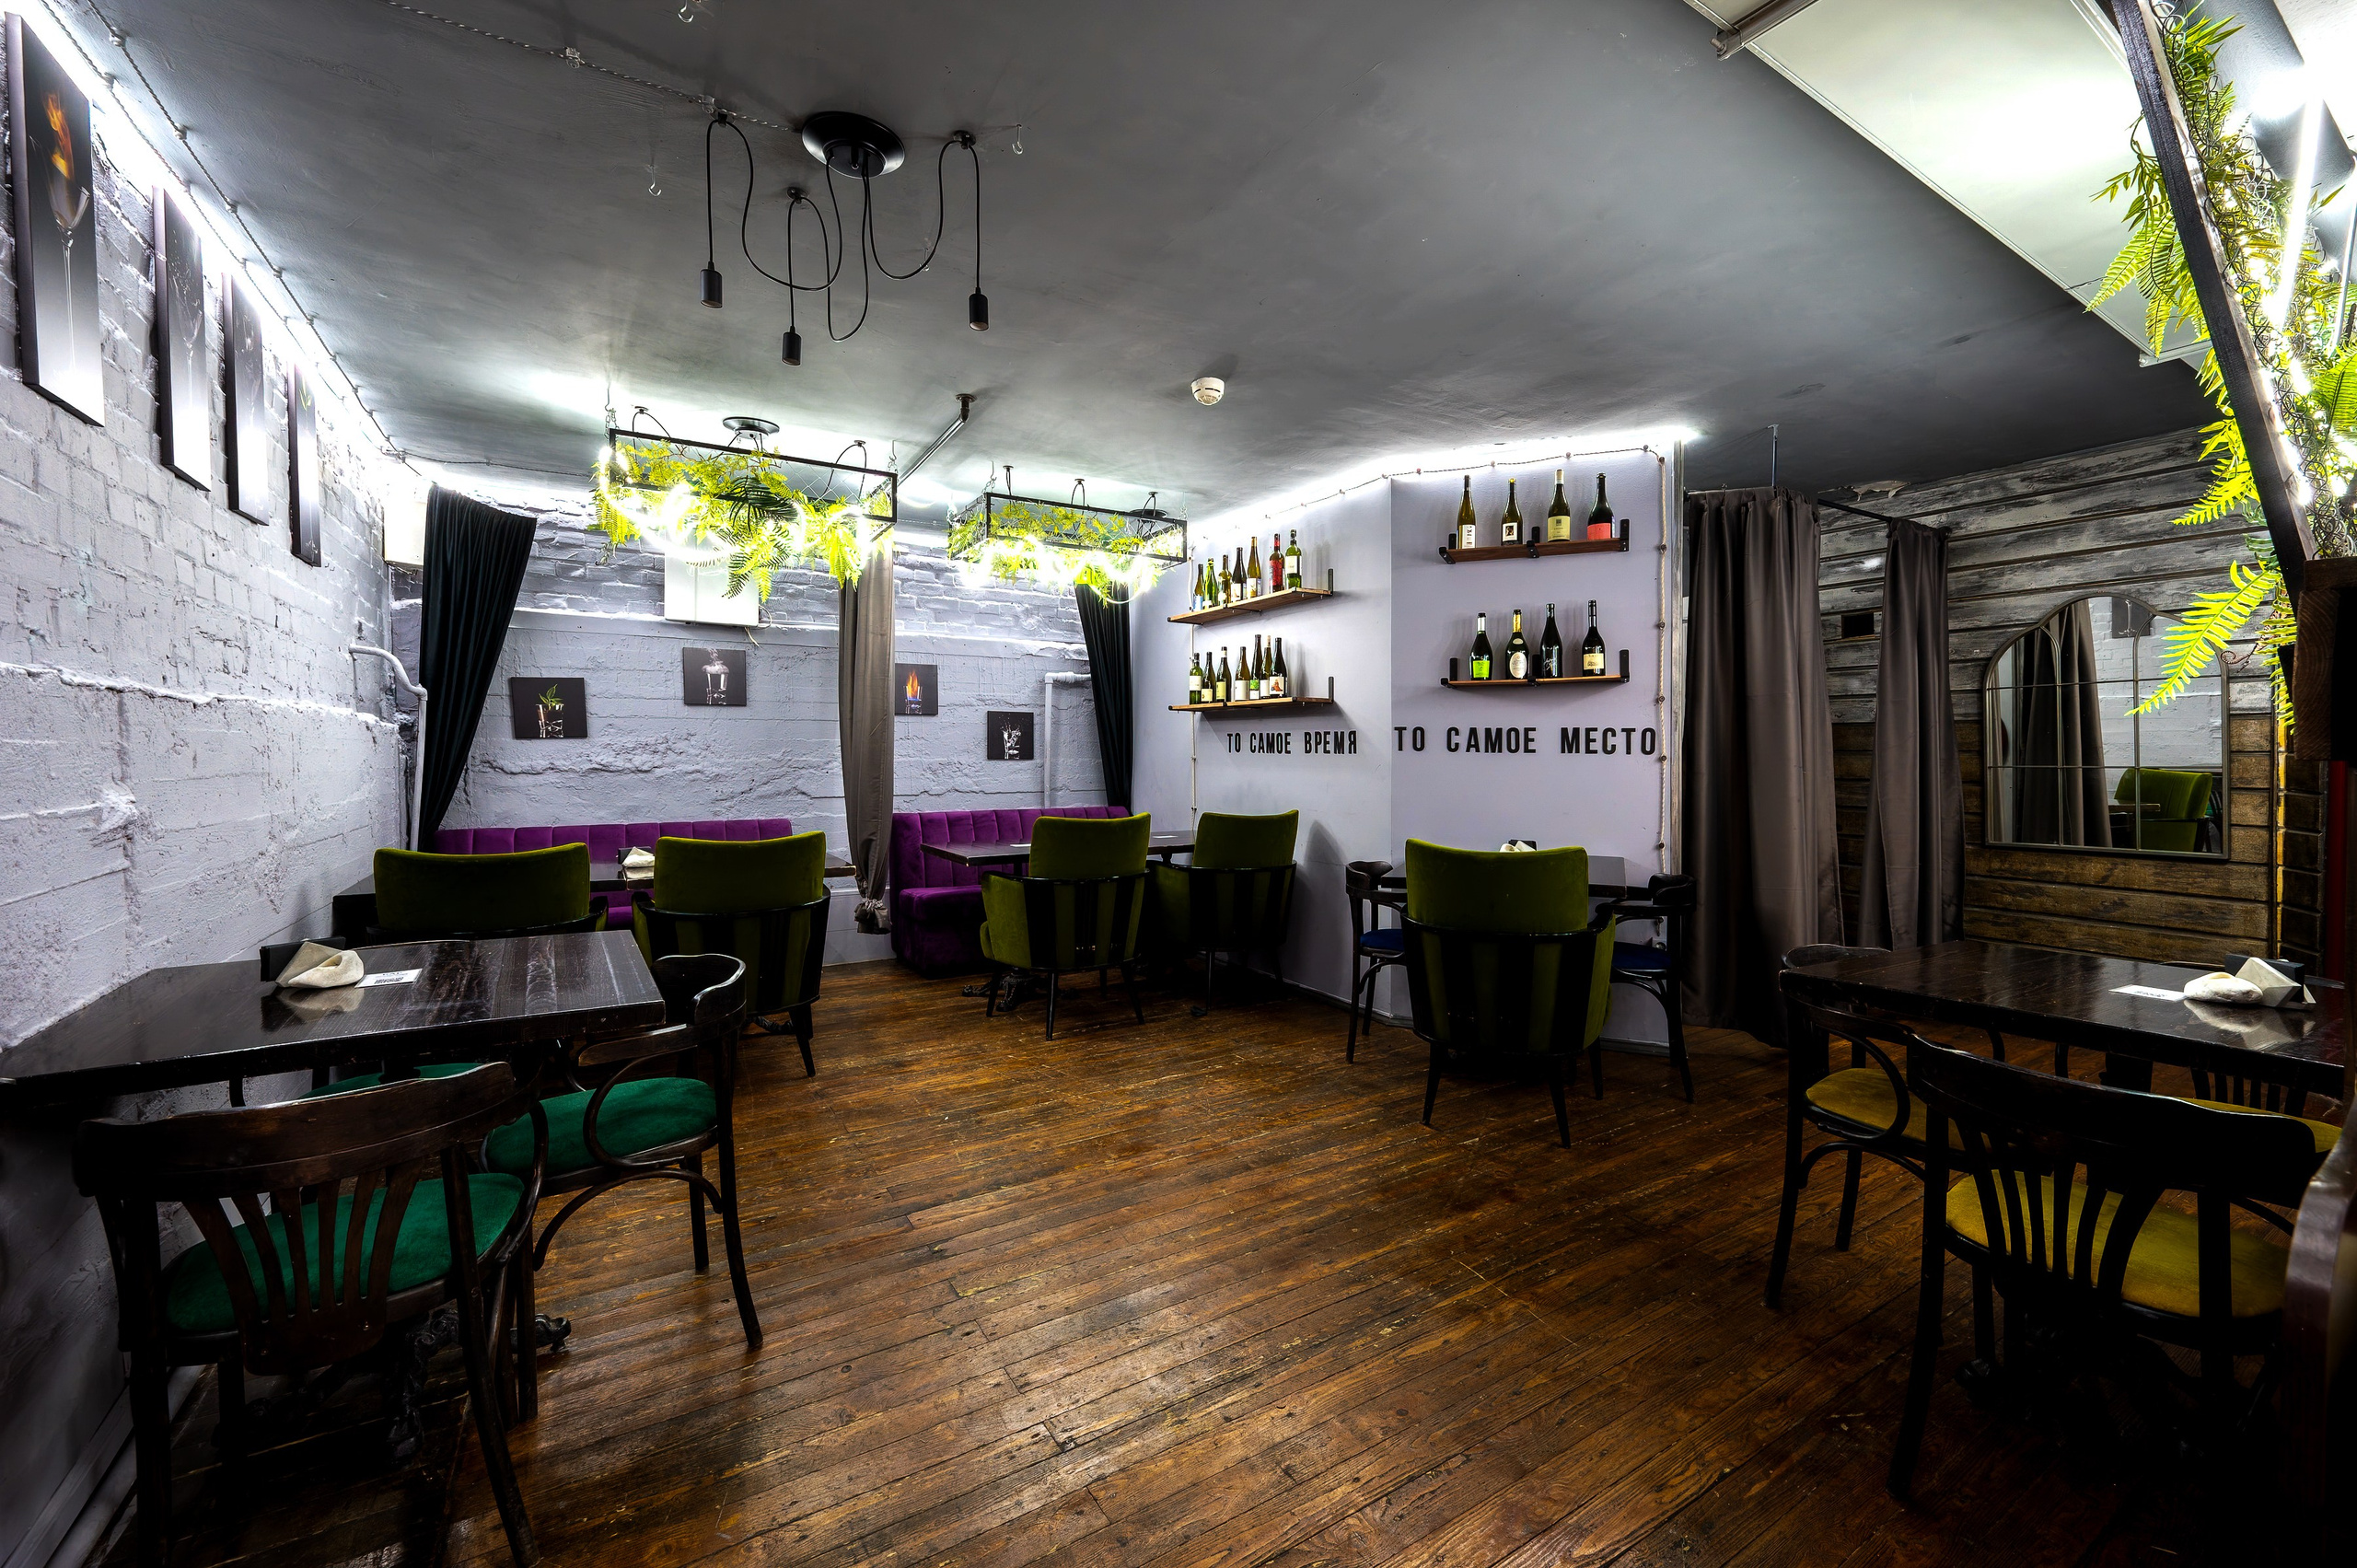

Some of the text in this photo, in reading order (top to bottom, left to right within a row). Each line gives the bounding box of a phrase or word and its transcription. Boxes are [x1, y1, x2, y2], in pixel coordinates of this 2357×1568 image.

[1226, 730, 1357, 755] ТО САМОЕ ВРЕМЯ
[1393, 726, 1656, 756] ТО САМОЕ МЕСТО
